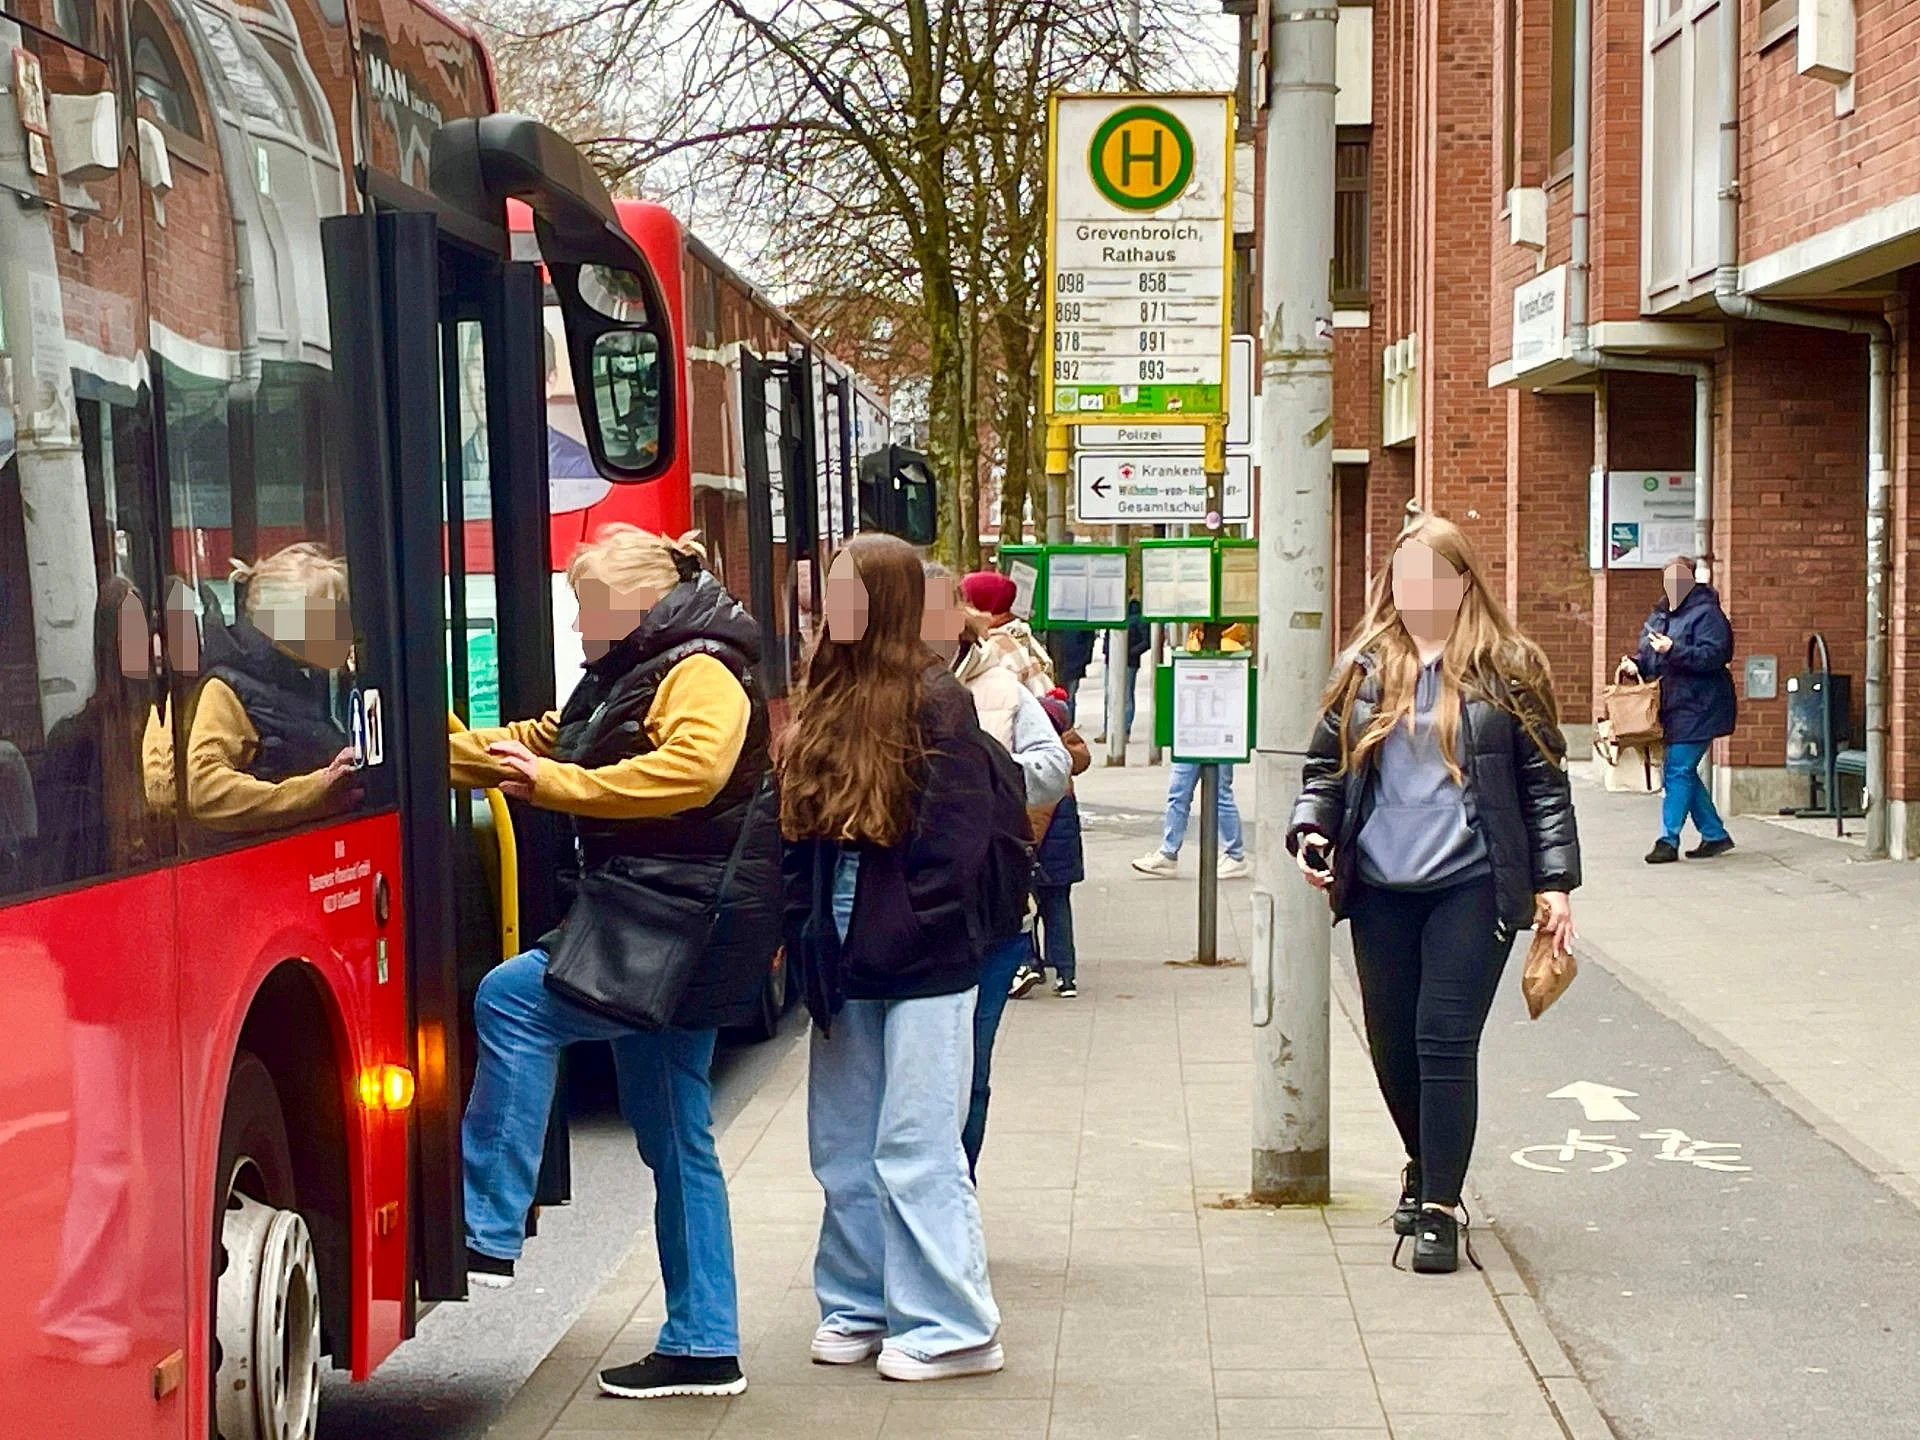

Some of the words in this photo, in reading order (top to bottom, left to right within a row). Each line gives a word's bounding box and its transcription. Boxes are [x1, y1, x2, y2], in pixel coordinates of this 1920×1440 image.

[368, 53, 409, 107] MAN
[1121, 129, 1163, 187] H
[1102, 247, 1177, 263] Rathaus
[1057, 273, 1084, 293] 098
[1139, 272, 1166, 293] 858
[1055, 302, 1081, 322] 869
[1140, 302, 1166, 322] 871
[1054, 331, 1080, 352] 878
[1139, 331, 1166, 352] 891
[1054, 360, 1079, 381] 892
[1139, 360, 1165, 380] 893
[1117, 429, 1163, 441] Polizei
[1117, 501, 1205, 513] Gesamtschul
